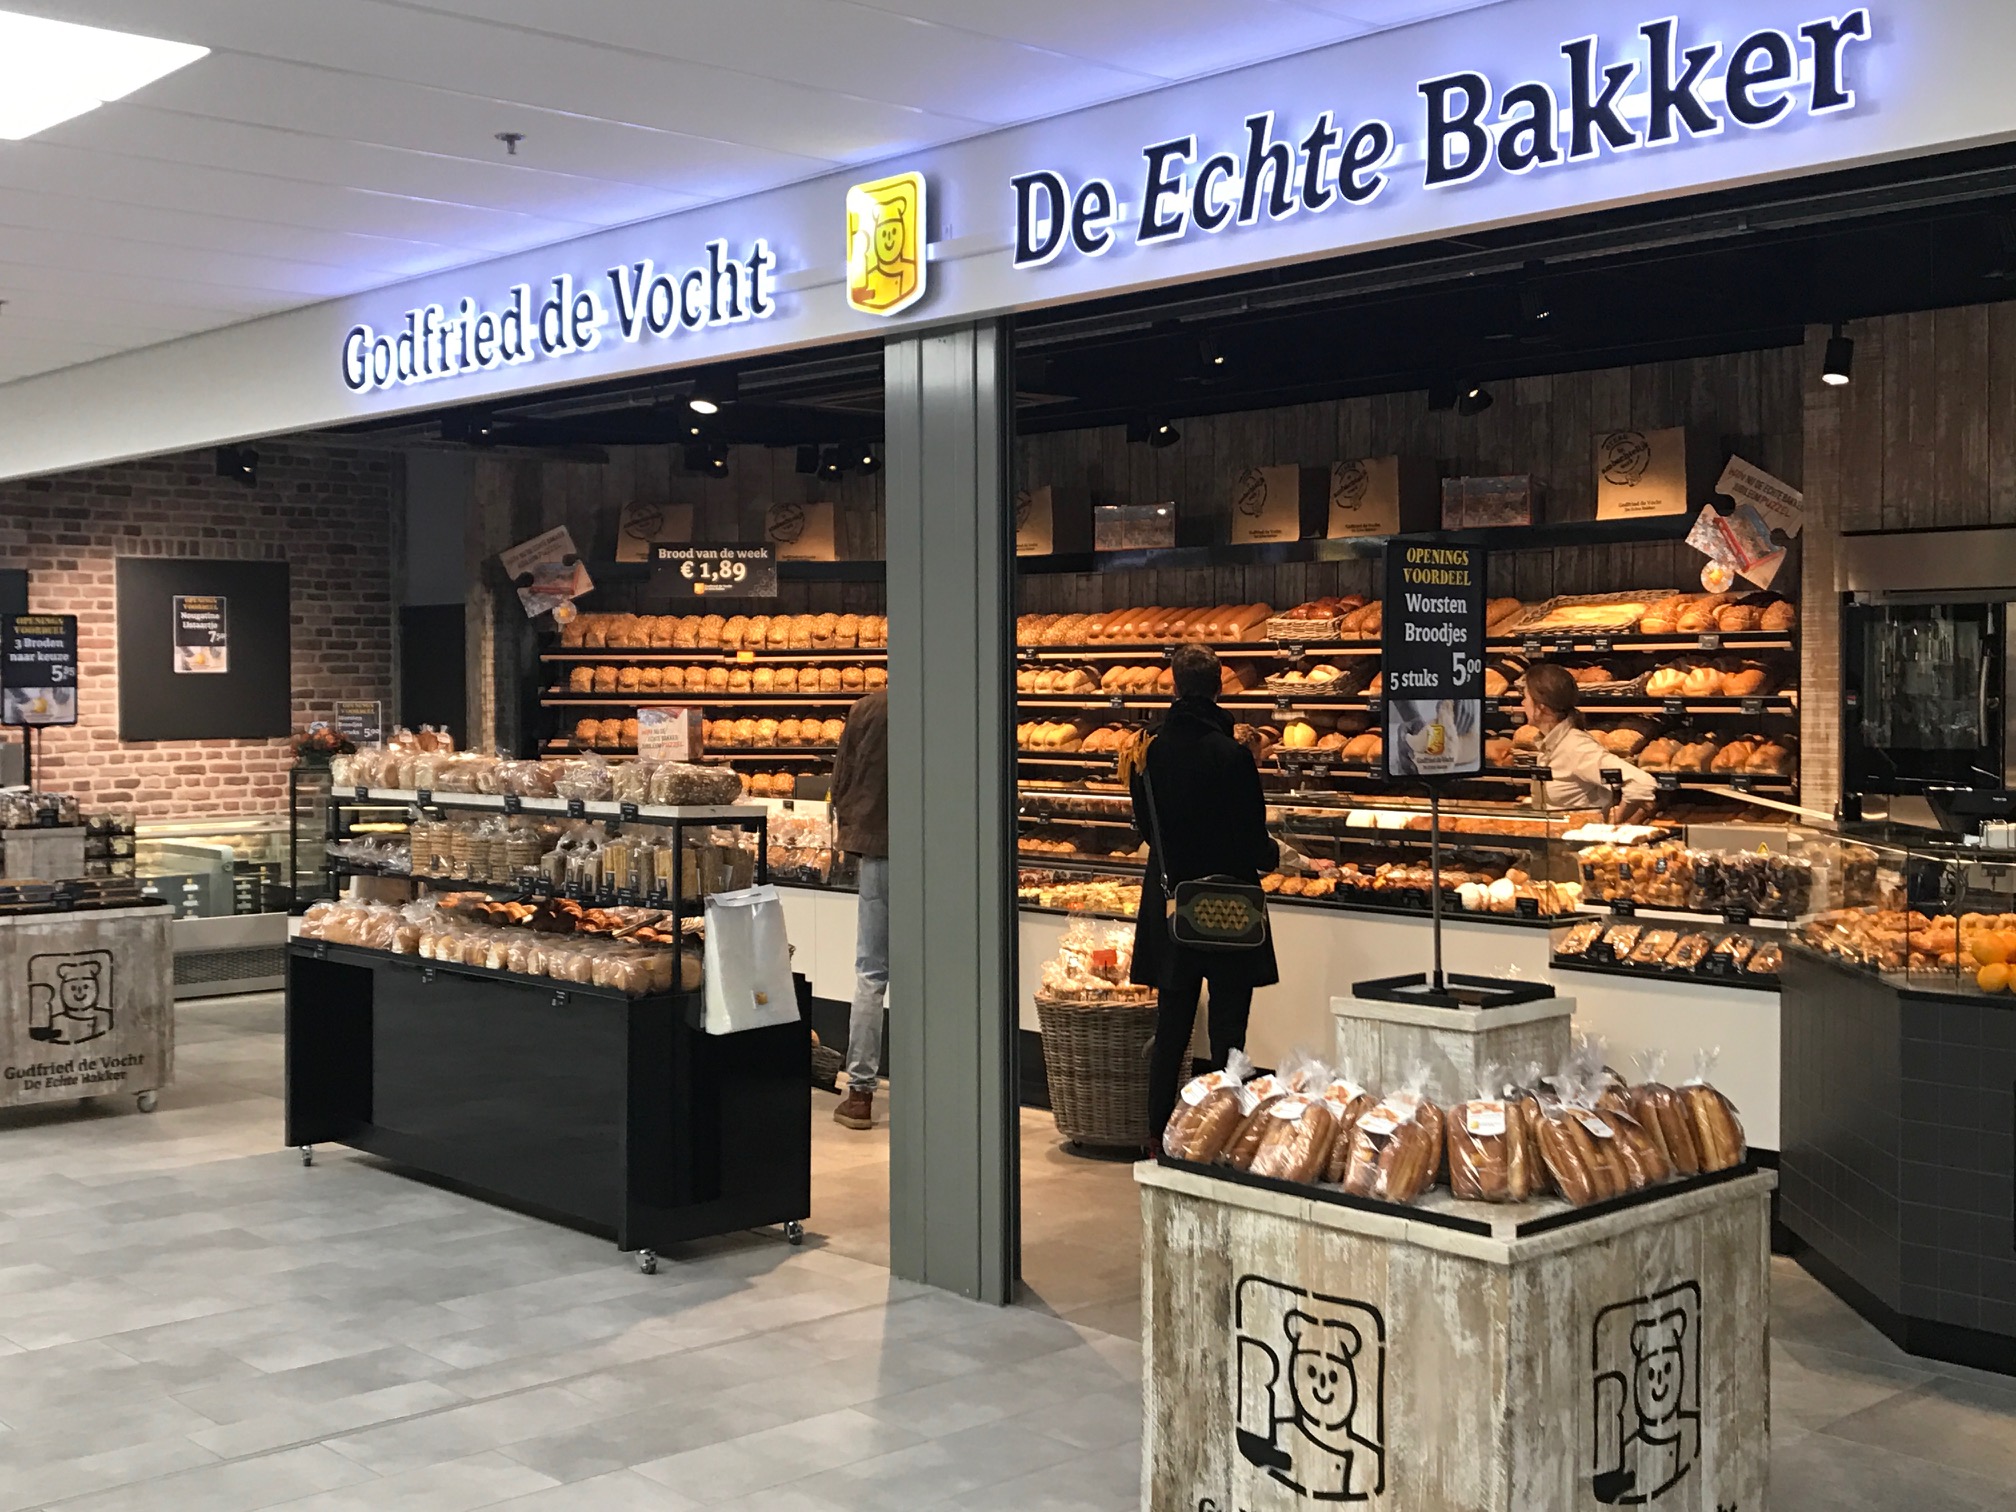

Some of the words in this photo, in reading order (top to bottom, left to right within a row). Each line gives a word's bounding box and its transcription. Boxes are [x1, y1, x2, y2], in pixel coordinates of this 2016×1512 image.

[1010, 169, 1115, 269] De
[1136, 110, 1394, 246] Echte
[1418, 8, 1872, 190] Bakker
[343, 283, 530, 393] Godfried
[539, 274, 596, 357] de
[607, 238, 775, 342] Vocht
[658, 548, 694, 559] Brood
[695, 550, 718, 559] van
[720, 548, 735, 559] de
[737, 548, 768, 559] week
[1406, 547, 1469, 566] OPENINGS
[680, 560, 695, 578] €
[700, 560, 746, 581] 1,89
[1403, 568, 1471, 586] VOORDEEL
[1405, 593, 1467, 614] Worsten
[14, 639, 22, 650] 3
[24, 638, 64, 648] Broden
[1405, 623, 1467, 647] Broodjes
[9, 653, 35, 662] naar
[37, 651, 70, 662] keuze
[1390, 672, 1399, 690] 5
[1402, 669, 1438, 687] stuks
[78, 1058, 96, 1071] de
[99, 1053, 145, 1068] Vocht
